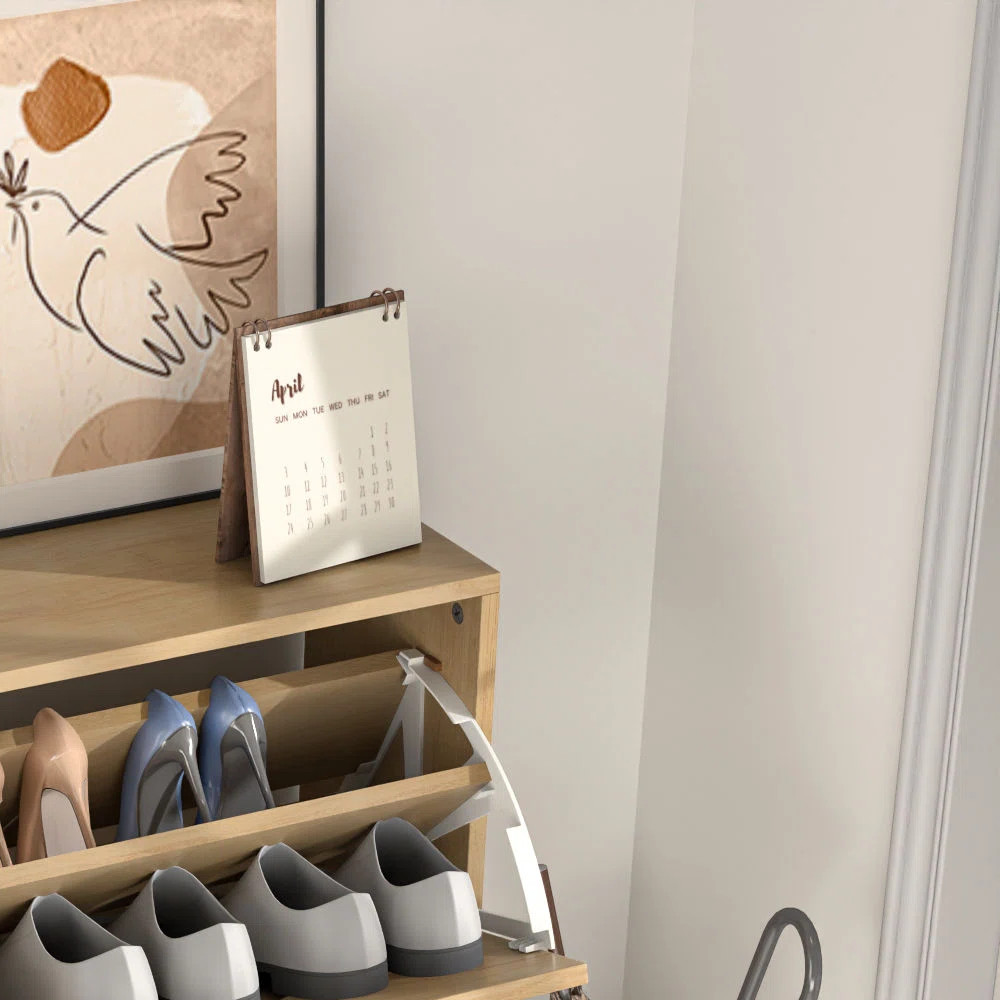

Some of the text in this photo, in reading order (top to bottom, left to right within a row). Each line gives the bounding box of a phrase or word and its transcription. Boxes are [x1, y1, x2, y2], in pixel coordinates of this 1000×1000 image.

[271, 372, 305, 405] April
[275, 389, 390, 424] SUN MON TUE WED THU FRI SAT
